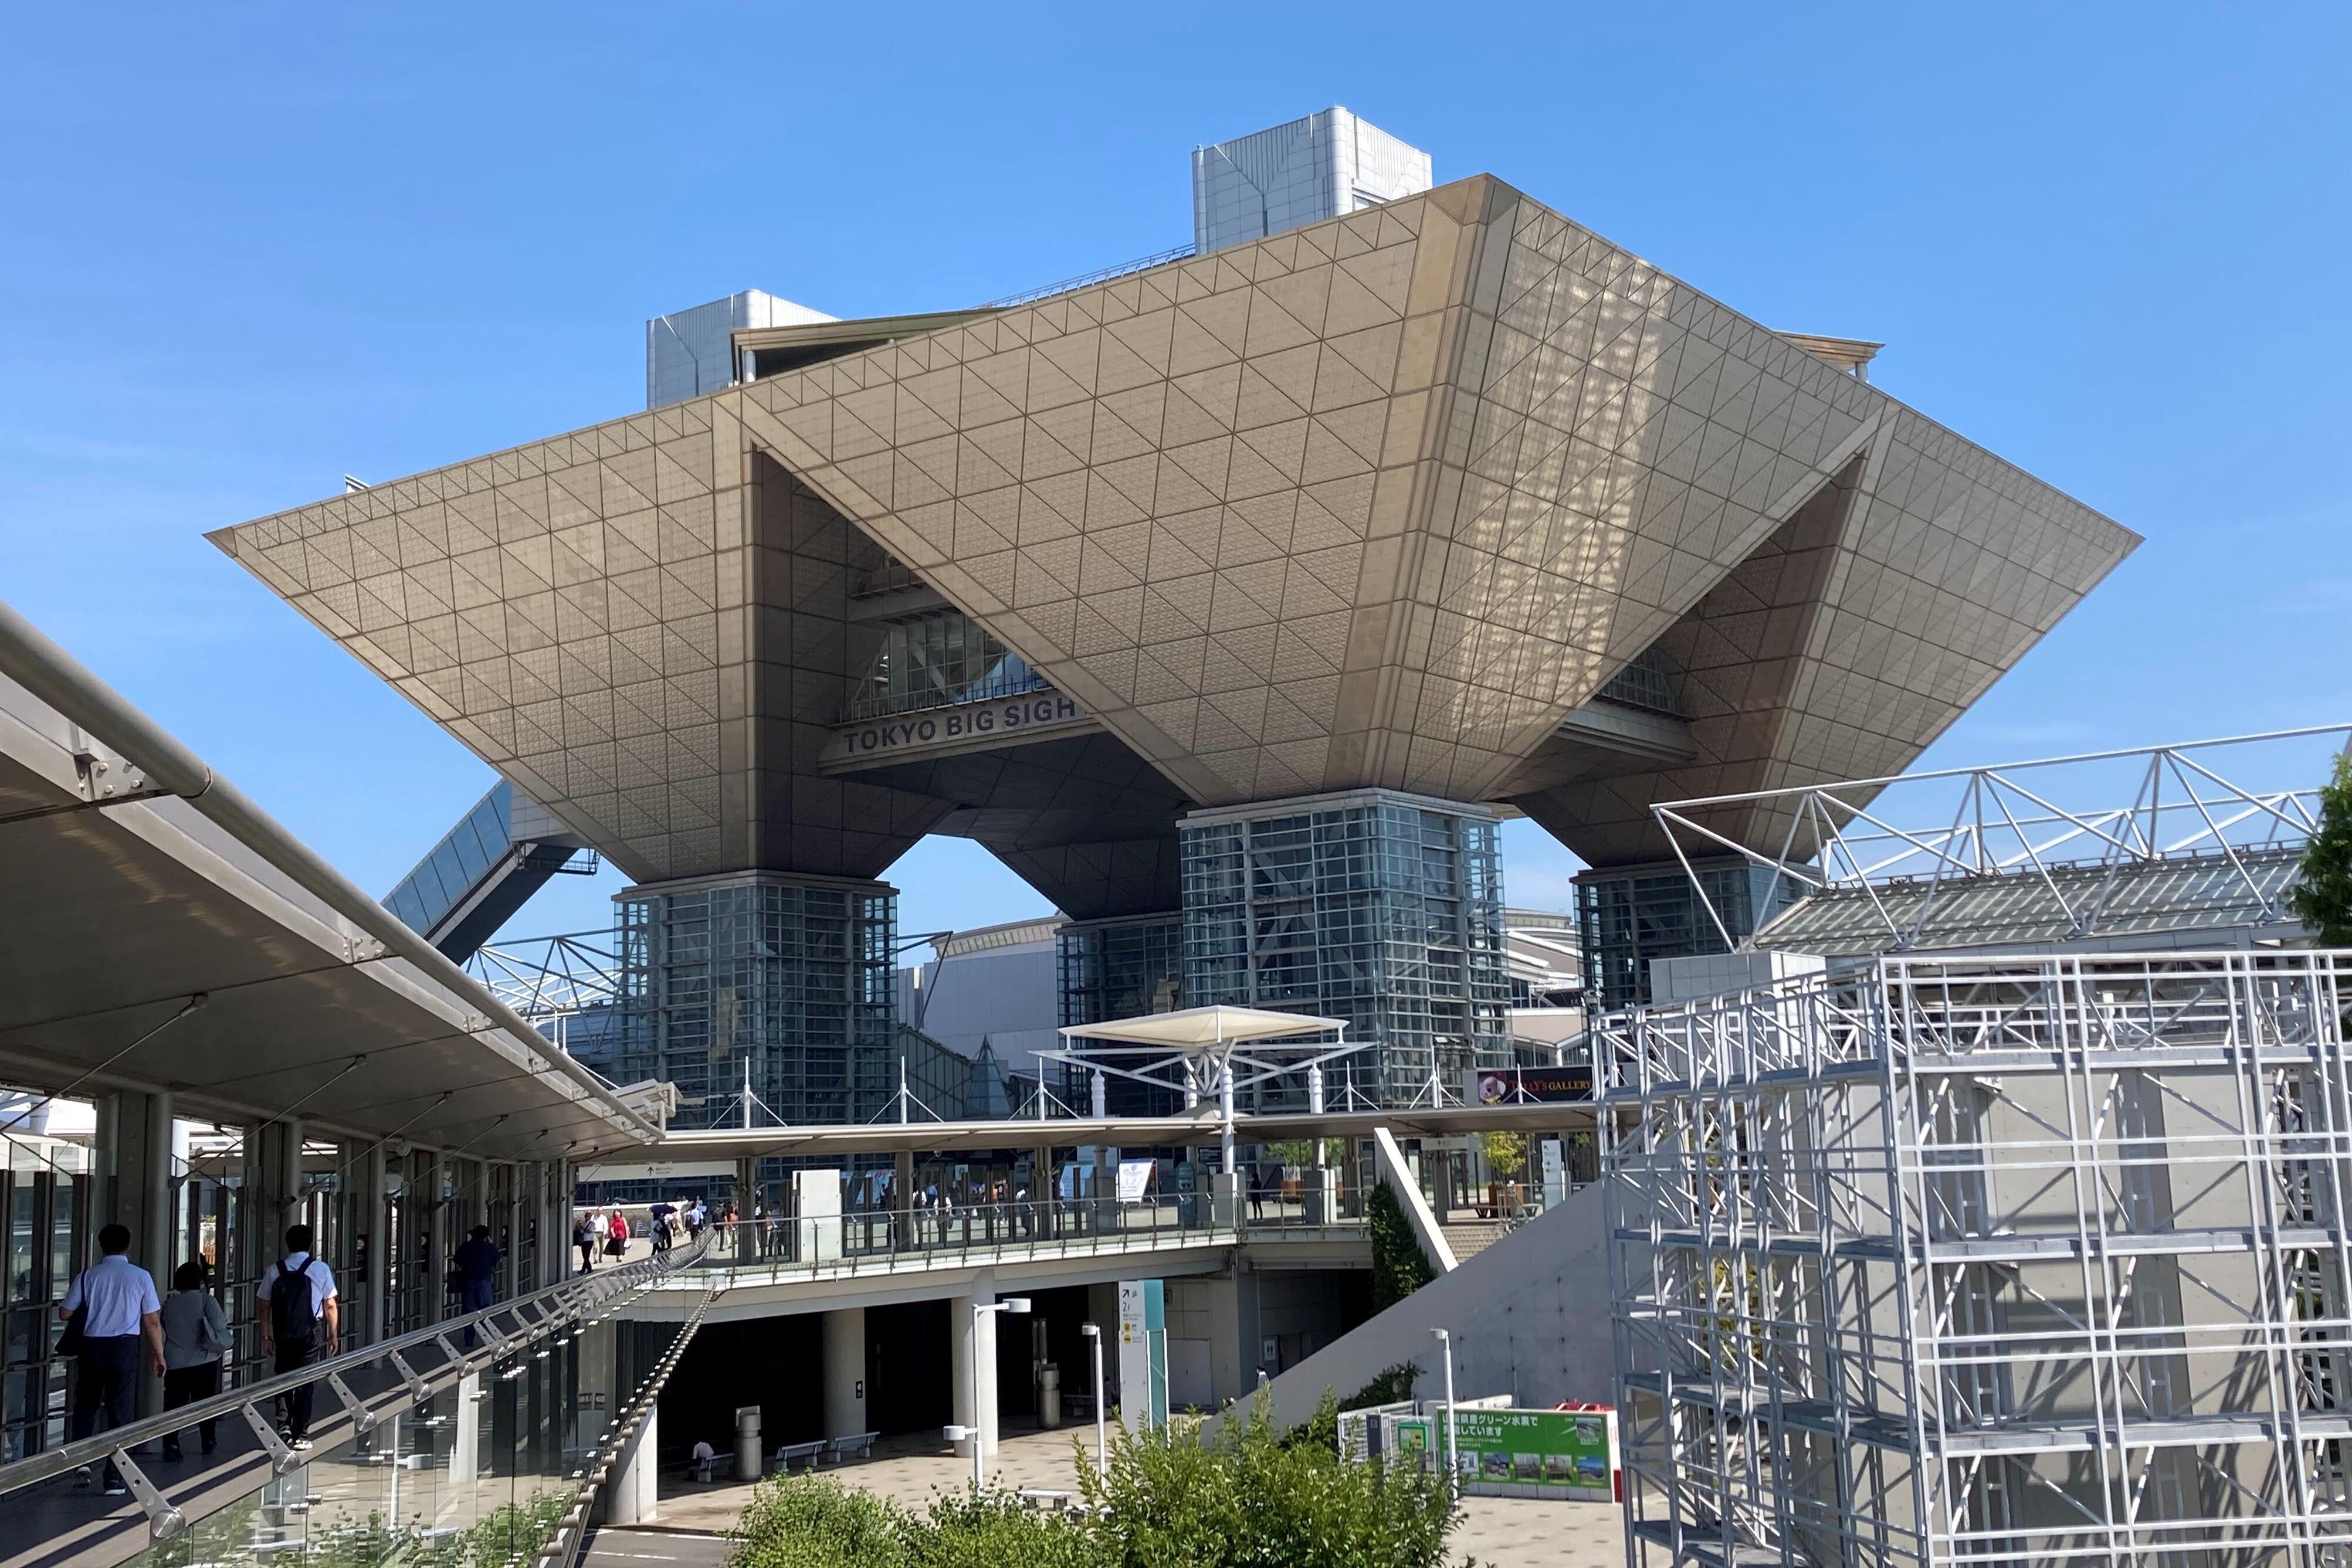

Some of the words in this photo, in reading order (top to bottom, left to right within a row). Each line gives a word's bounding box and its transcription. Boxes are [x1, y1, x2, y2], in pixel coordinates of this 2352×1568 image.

[842, 719, 936, 753] TOKYO
[947, 710, 994, 737] BIG
[1005, 697, 1076, 727] SIGH
[1508, 1080, 1547, 1091] TLLY'S
[1548, 1080, 1591, 1091] GALLERY
